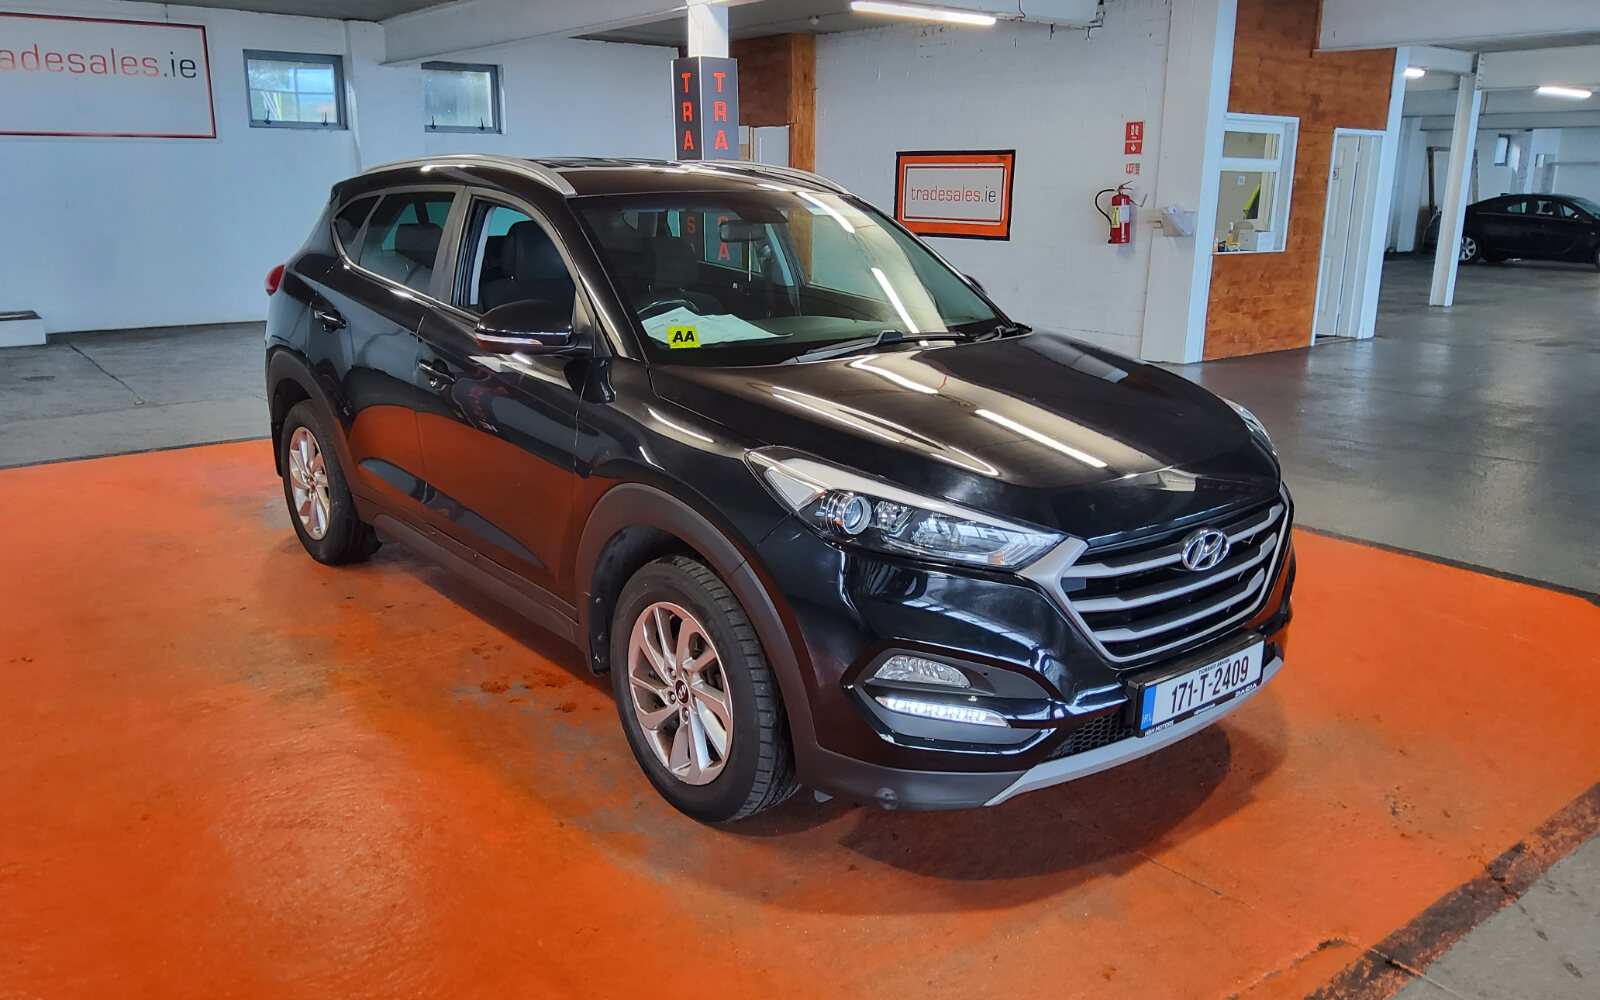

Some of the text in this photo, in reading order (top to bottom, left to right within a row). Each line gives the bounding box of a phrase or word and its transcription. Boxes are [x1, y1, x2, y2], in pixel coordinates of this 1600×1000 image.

[713, 72, 729, 161] TRA
[911, 185, 996, 203] tradesales.ie
[672, 330, 695, 343] AA
[1171, 656, 1249, 714] 171-T-2409
